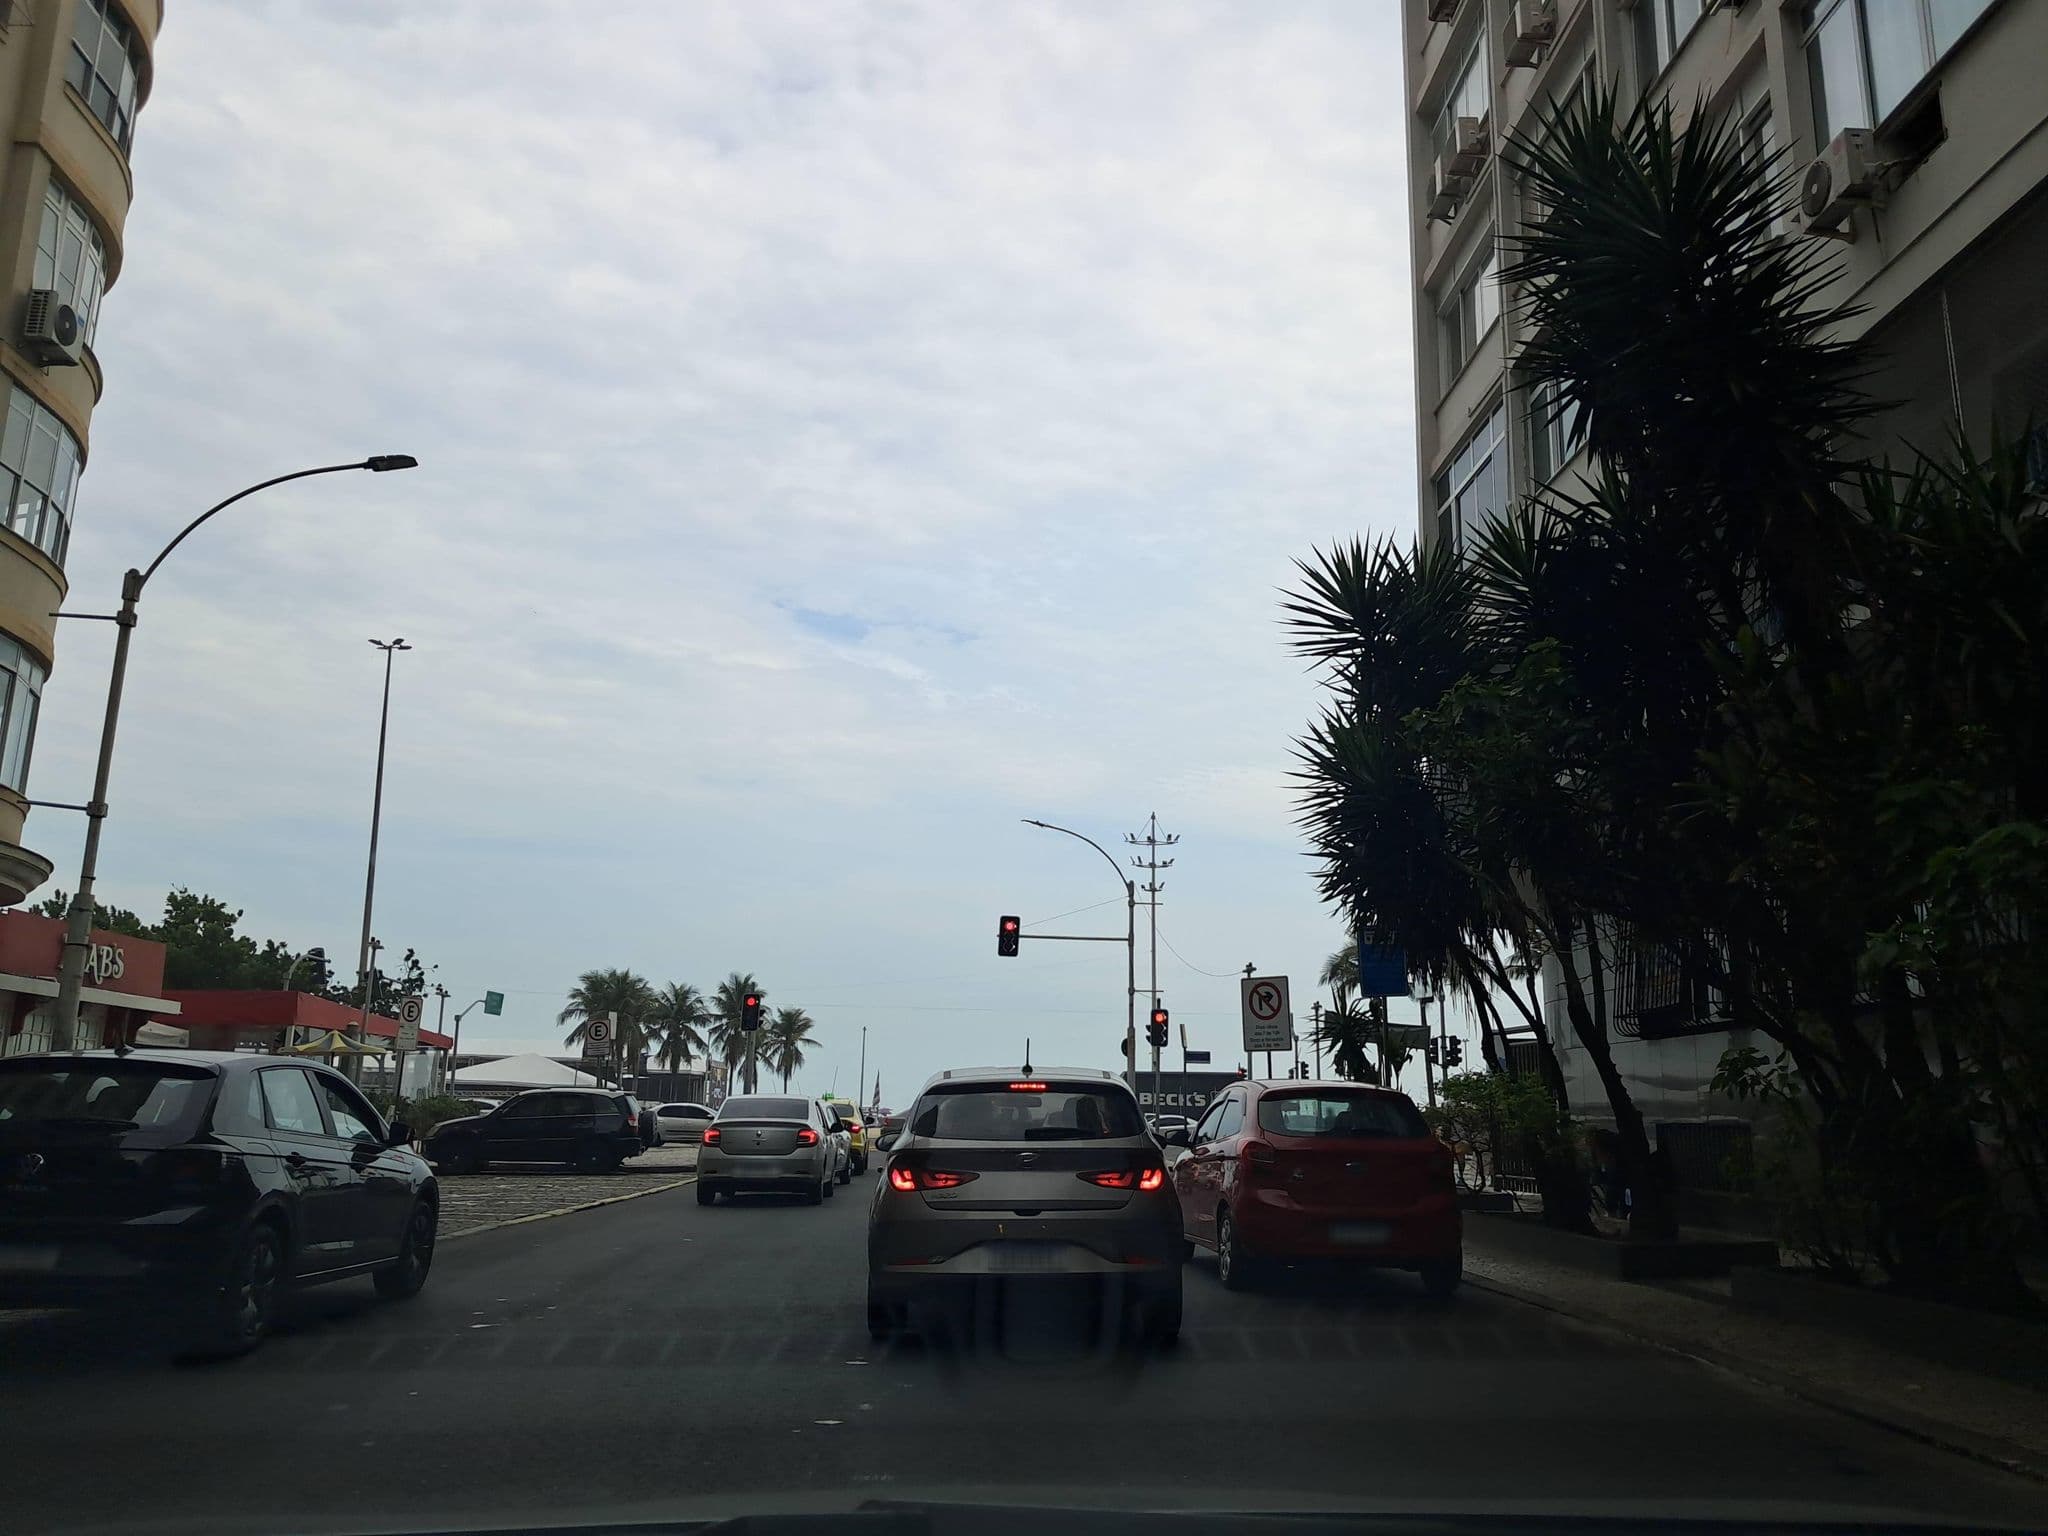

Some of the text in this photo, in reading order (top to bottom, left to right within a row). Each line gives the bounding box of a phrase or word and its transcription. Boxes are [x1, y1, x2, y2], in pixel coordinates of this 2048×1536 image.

[407, 1005, 415, 1018] E
[595, 1025, 603, 1037] E
[1139, 1091, 1207, 1107] BECK'S
